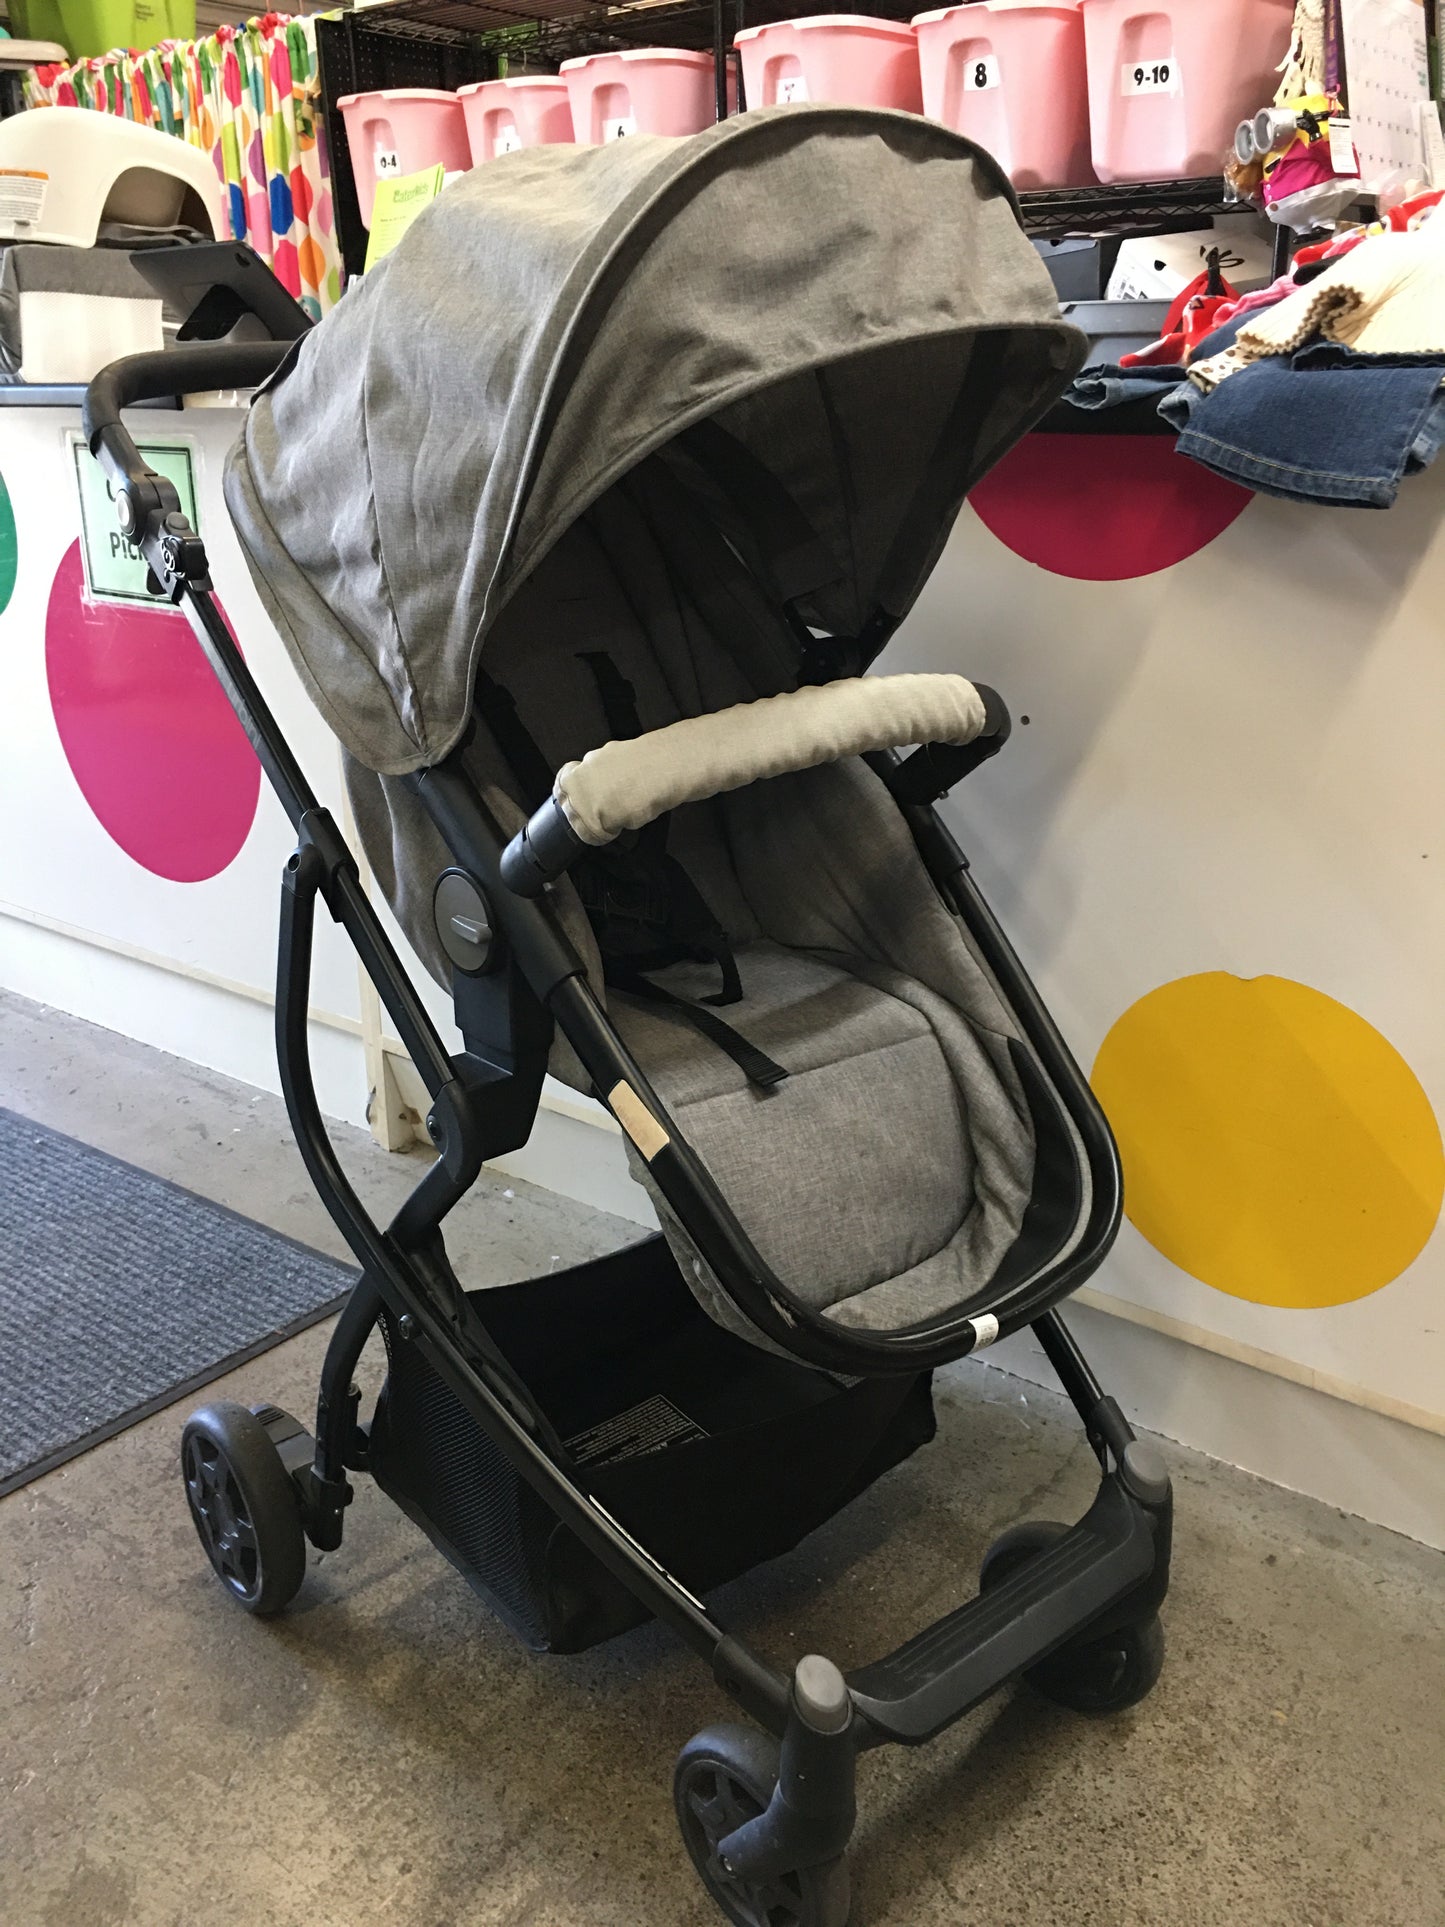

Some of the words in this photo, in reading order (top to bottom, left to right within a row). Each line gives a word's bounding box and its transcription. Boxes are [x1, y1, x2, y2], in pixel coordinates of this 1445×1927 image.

[975, 63, 987, 88] 8
[1134, 65, 1170, 86] 9-10
[380, 154, 397, 169] 0-4
